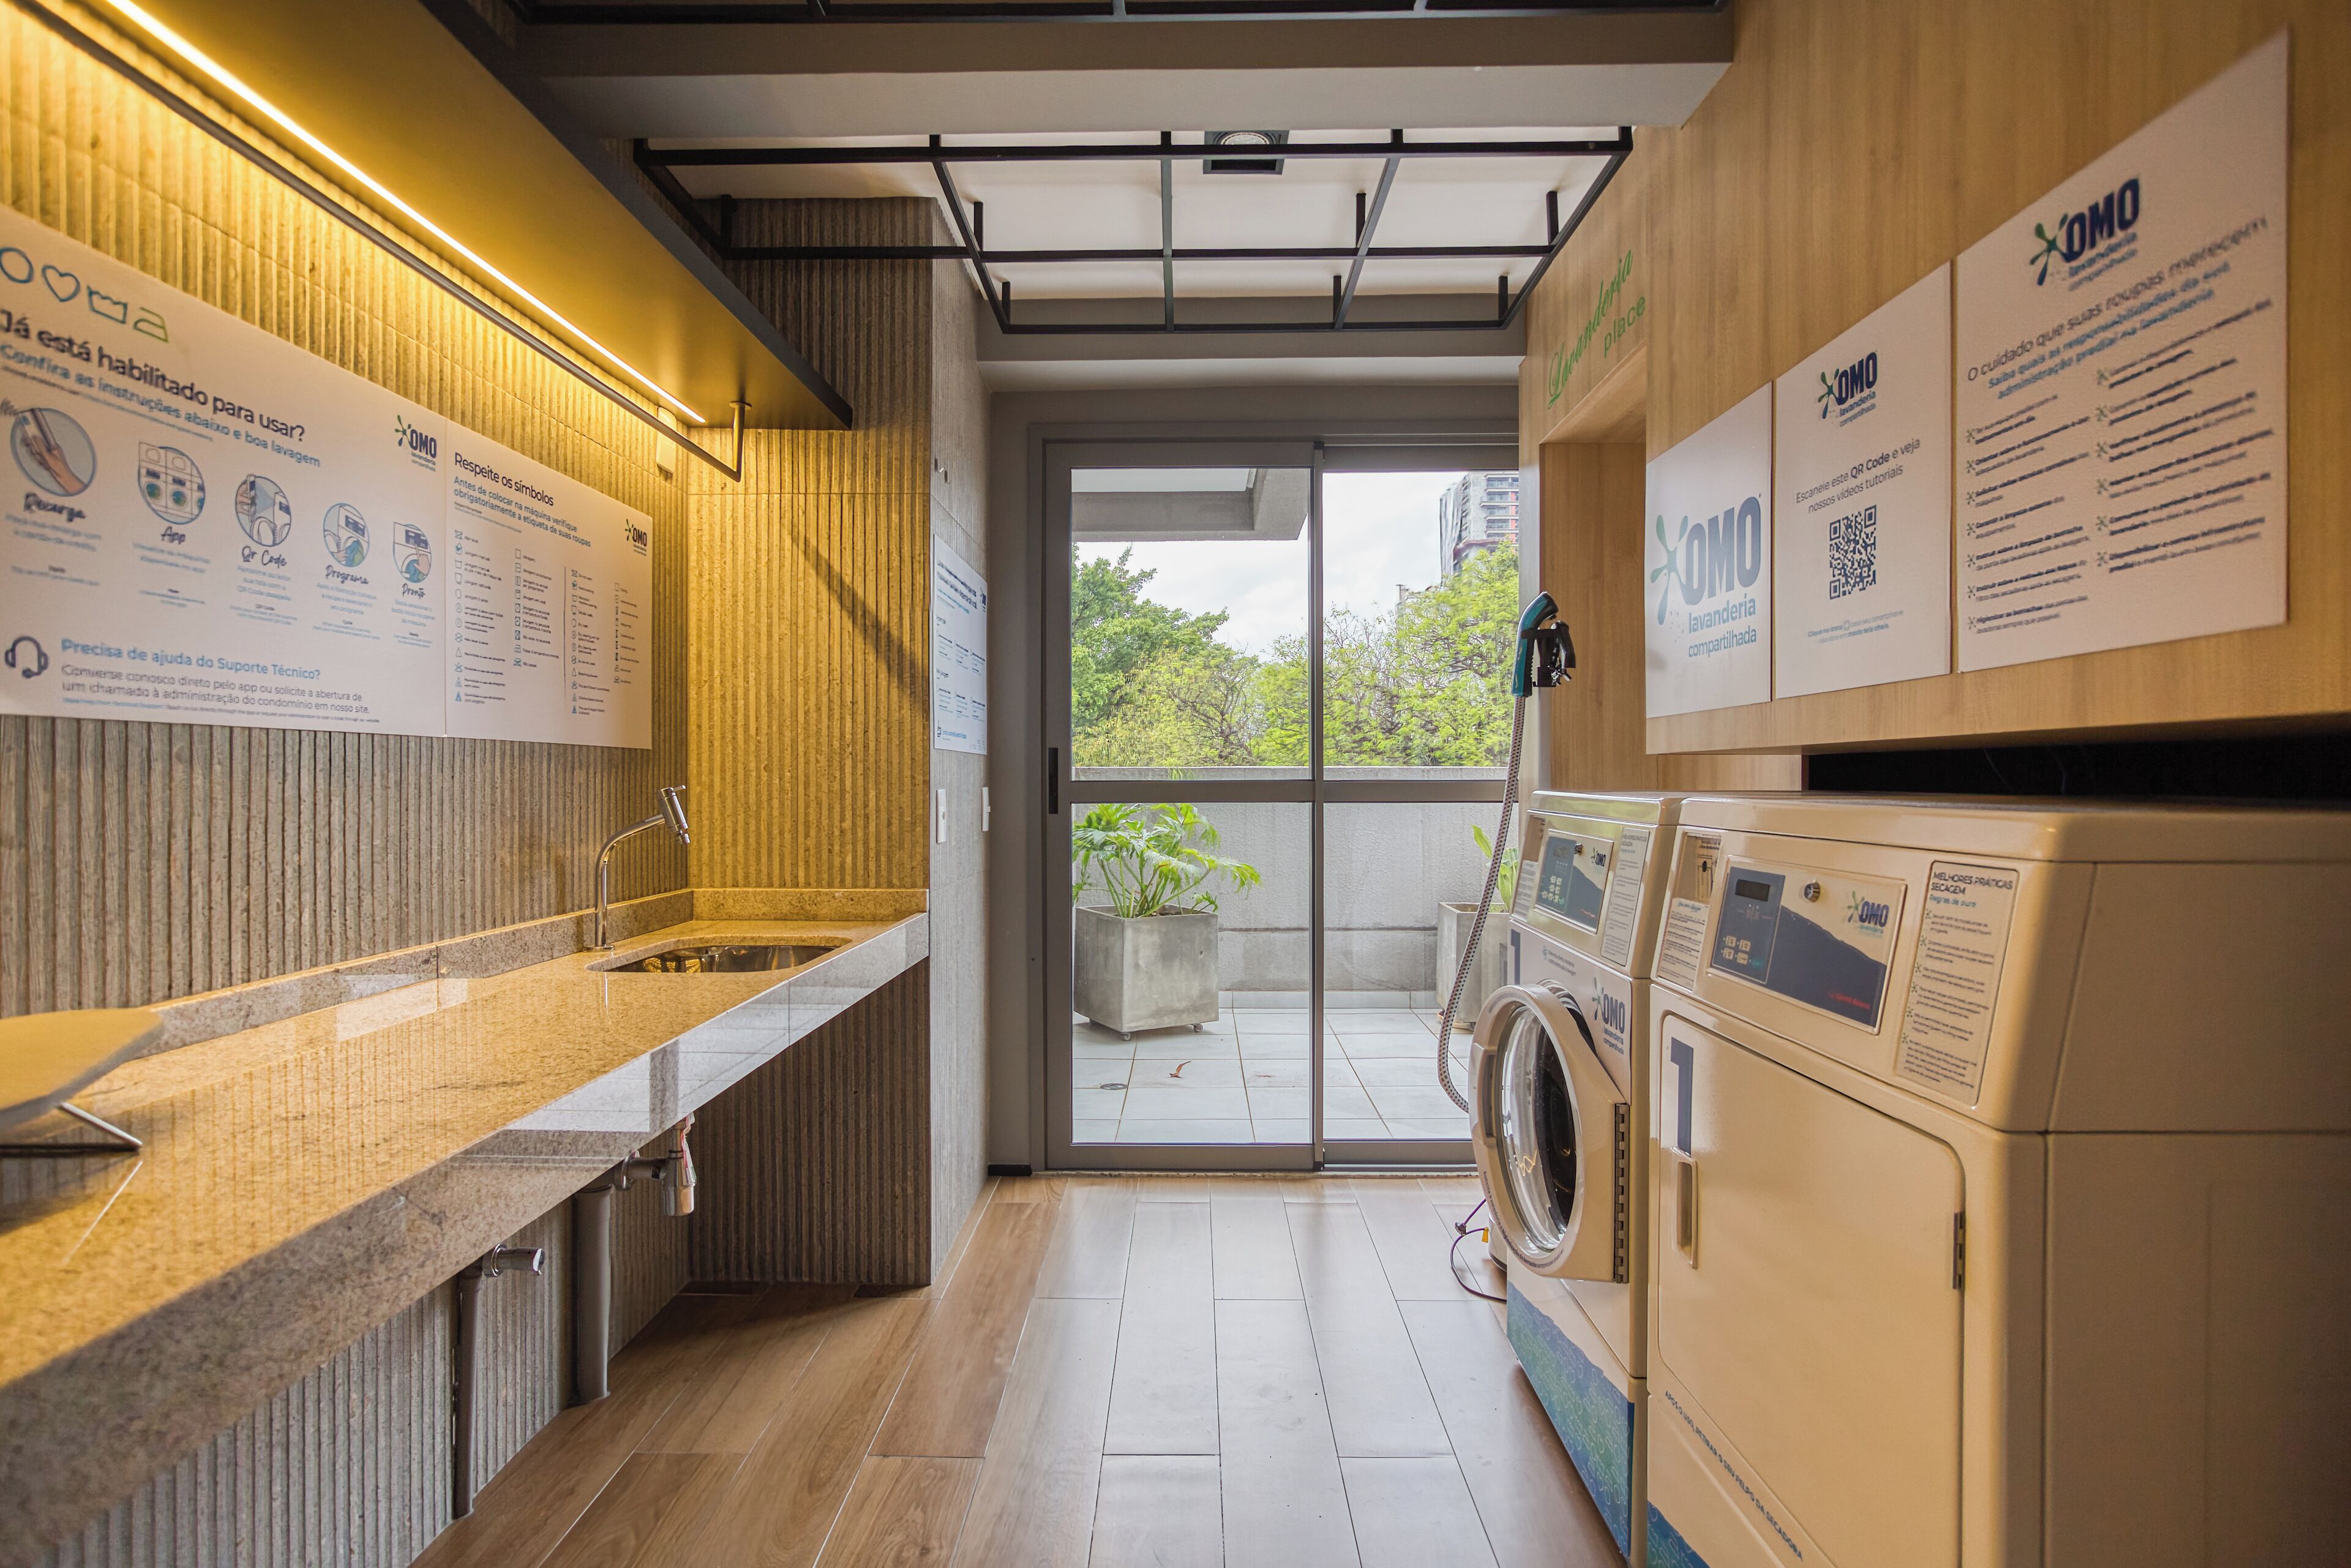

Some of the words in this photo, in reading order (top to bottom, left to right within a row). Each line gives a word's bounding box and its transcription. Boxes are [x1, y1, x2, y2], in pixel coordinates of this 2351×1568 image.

[2063, 178, 2140, 263] OMO
[1603, 295, 1646, 359] place
[1967, 367, 1979, 381] O
[1980, 340, 2034, 376] cuidado
[2036, 322, 2064, 347] que
[2067, 303, 2102, 331] suas
[0, 309, 30, 339] Já
[37, 329, 92, 362] está
[97, 345, 209, 406] habilitado
[212, 396, 255, 424] para
[259, 413, 305, 442] usar?
[1837, 351, 1878, 406] OMO
[233, 428, 242, 440] e
[245, 430, 268, 449] boa
[271, 440, 321, 468] lavagem
[410, 429, 437, 459] OMO
[454, 452, 500, 483] Respeite
[501, 475, 512, 489] os
[514, 480, 554, 506] símbolos
[1795, 480, 1831, 504] Escaneie
[1831, 471, 1849, 488] este
[1850, 463, 1865, 479] QR
[1865, 452, 1891, 471] Code
[1891, 449, 1899, 459] e
[1900, 438, 1921, 455] veja
[1808, 494, 1836, 514] nossos
[1836, 482, 1864, 501] vídeos
[1865, 463, 1904, 489] tutoriais
[454, 475, 476, 492] Antes
[478, 485, 487, 497] de
[488, 490, 514, 507] colocar
[514, 501, 523, 511] na
[523, 506, 552, 523] máquina
[552, 516, 577, 533] verifique
[454, 487, 517, 519] obrigatoriamente
[523, 516, 549, 531] etiqueta
[549, 525, 558, 535] de
[558, 528, 572, 540] suas
[572, 534, 591, 548] roupas
[261, 549, 288, 569] Code
[632, 527, 647, 547] OMO
[1682, 497, 1761, 606] OMO
[1688, 593, 1757, 634] lavanderia
[61, 638, 124, 659] Precisa
[127, 647, 148, 661] de
[151, 650, 193, 666] ajuda
[196, 655, 214, 669] do
[217, 657, 269, 674] Suporte
[271, 664, 321, 680] Técnico?
[1688, 625, 1757, 658] compartilhada
[61, 664, 124, 680] Converse
[126, 672, 176, 686] conosco
[178, 675, 211, 689] direto
[213, 679, 236, 691] pelo
[238, 682, 258, 694] app
[260, 685, 273, 694] ou
[275, 686, 306, 697] solicite
[315, 689, 351, 701] abertura
[352, 692, 363, 702] de
[62, 680, 85, 692] um
[89, 681, 150, 697] chamado
[162, 689, 240, 705] administração
[242, 694, 255, 705] do
[257, 696, 313, 710] condomínio
[314, 702, 329, 711] em
[330, 704, 354, 713] nosso
[355, 705, 370, 714] site.
[1859, 900, 1890, 928] OMO
[1602, 993, 1625, 1034] OMO
